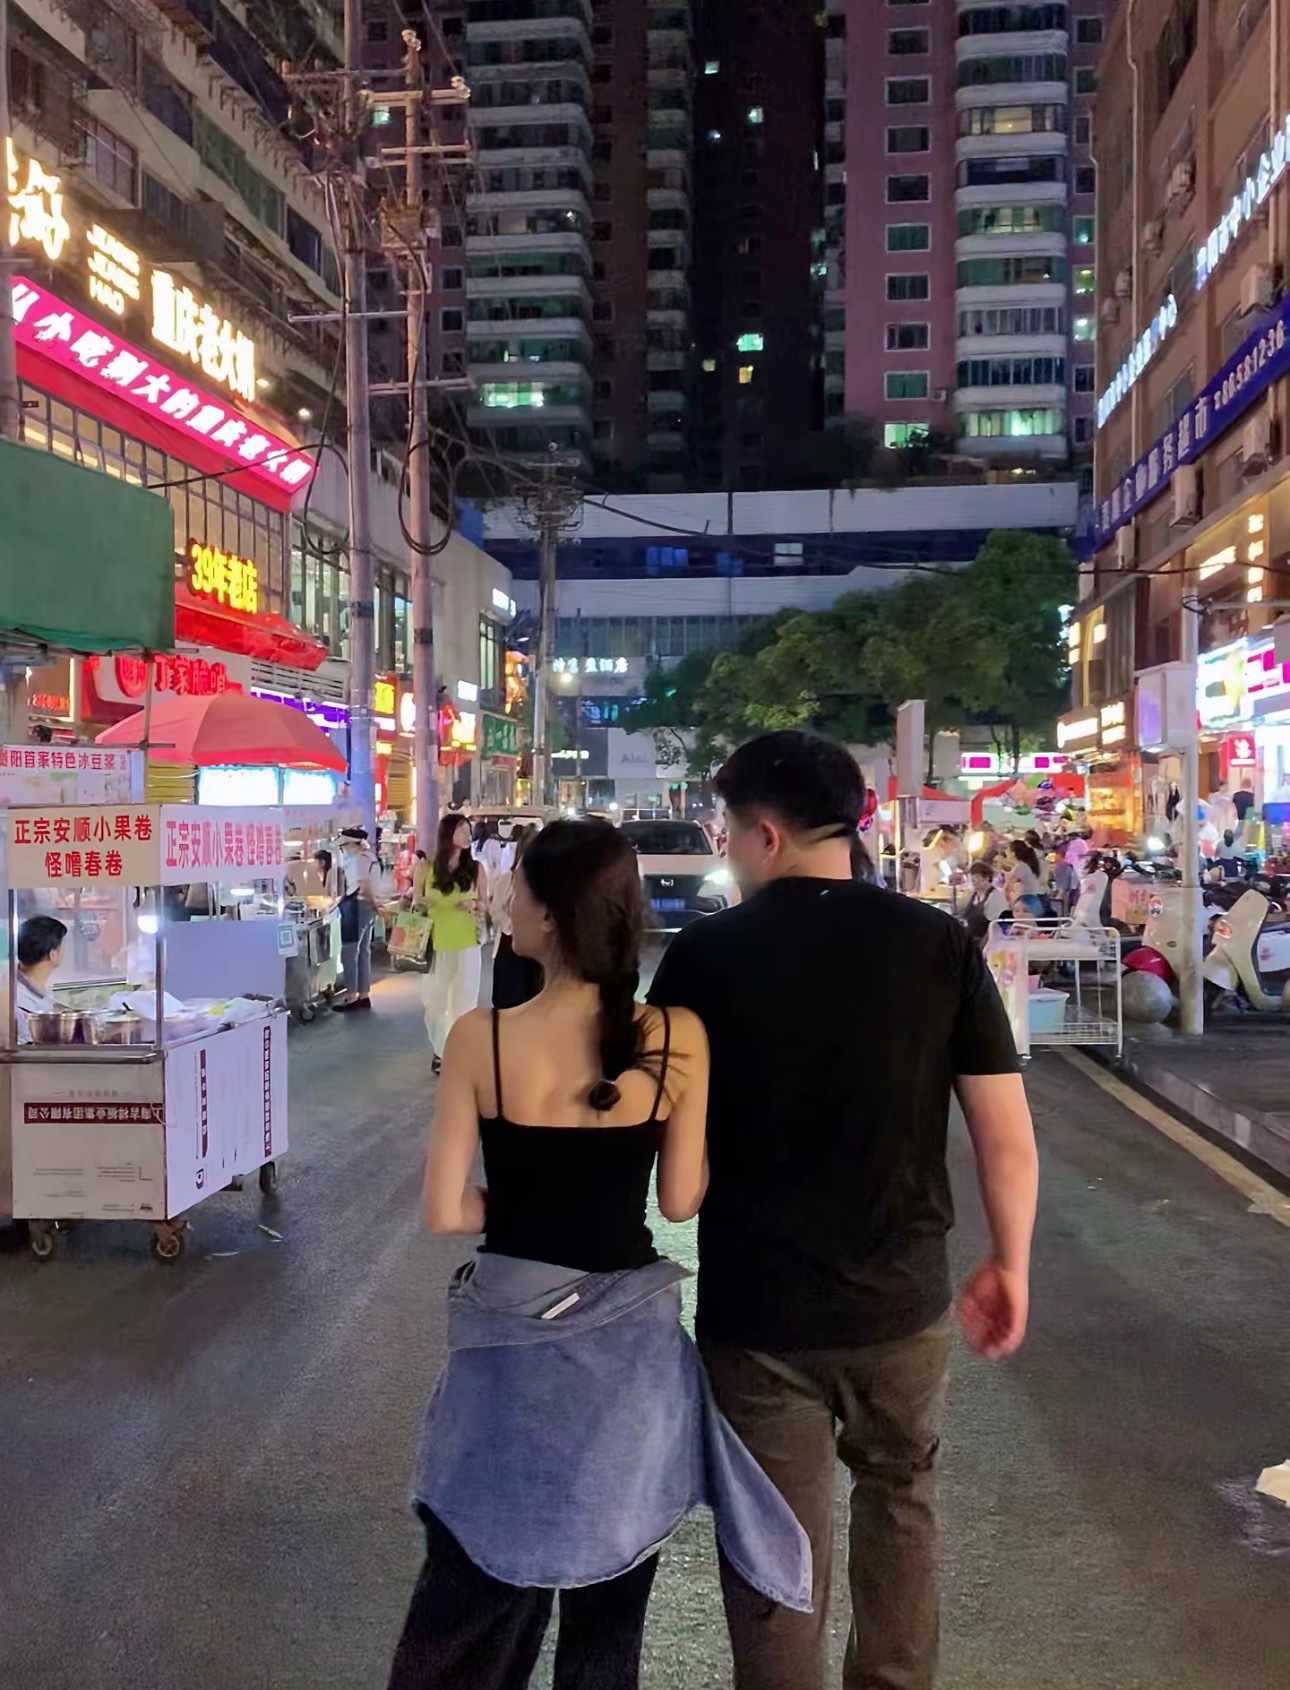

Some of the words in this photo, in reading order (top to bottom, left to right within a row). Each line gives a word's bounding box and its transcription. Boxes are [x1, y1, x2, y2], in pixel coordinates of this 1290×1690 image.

[191, 544, 258, 614] 39年老店
[14, 814, 153, 845] 正宗安顺小果卷
[45, 849, 123, 878] 怪噜春卷
